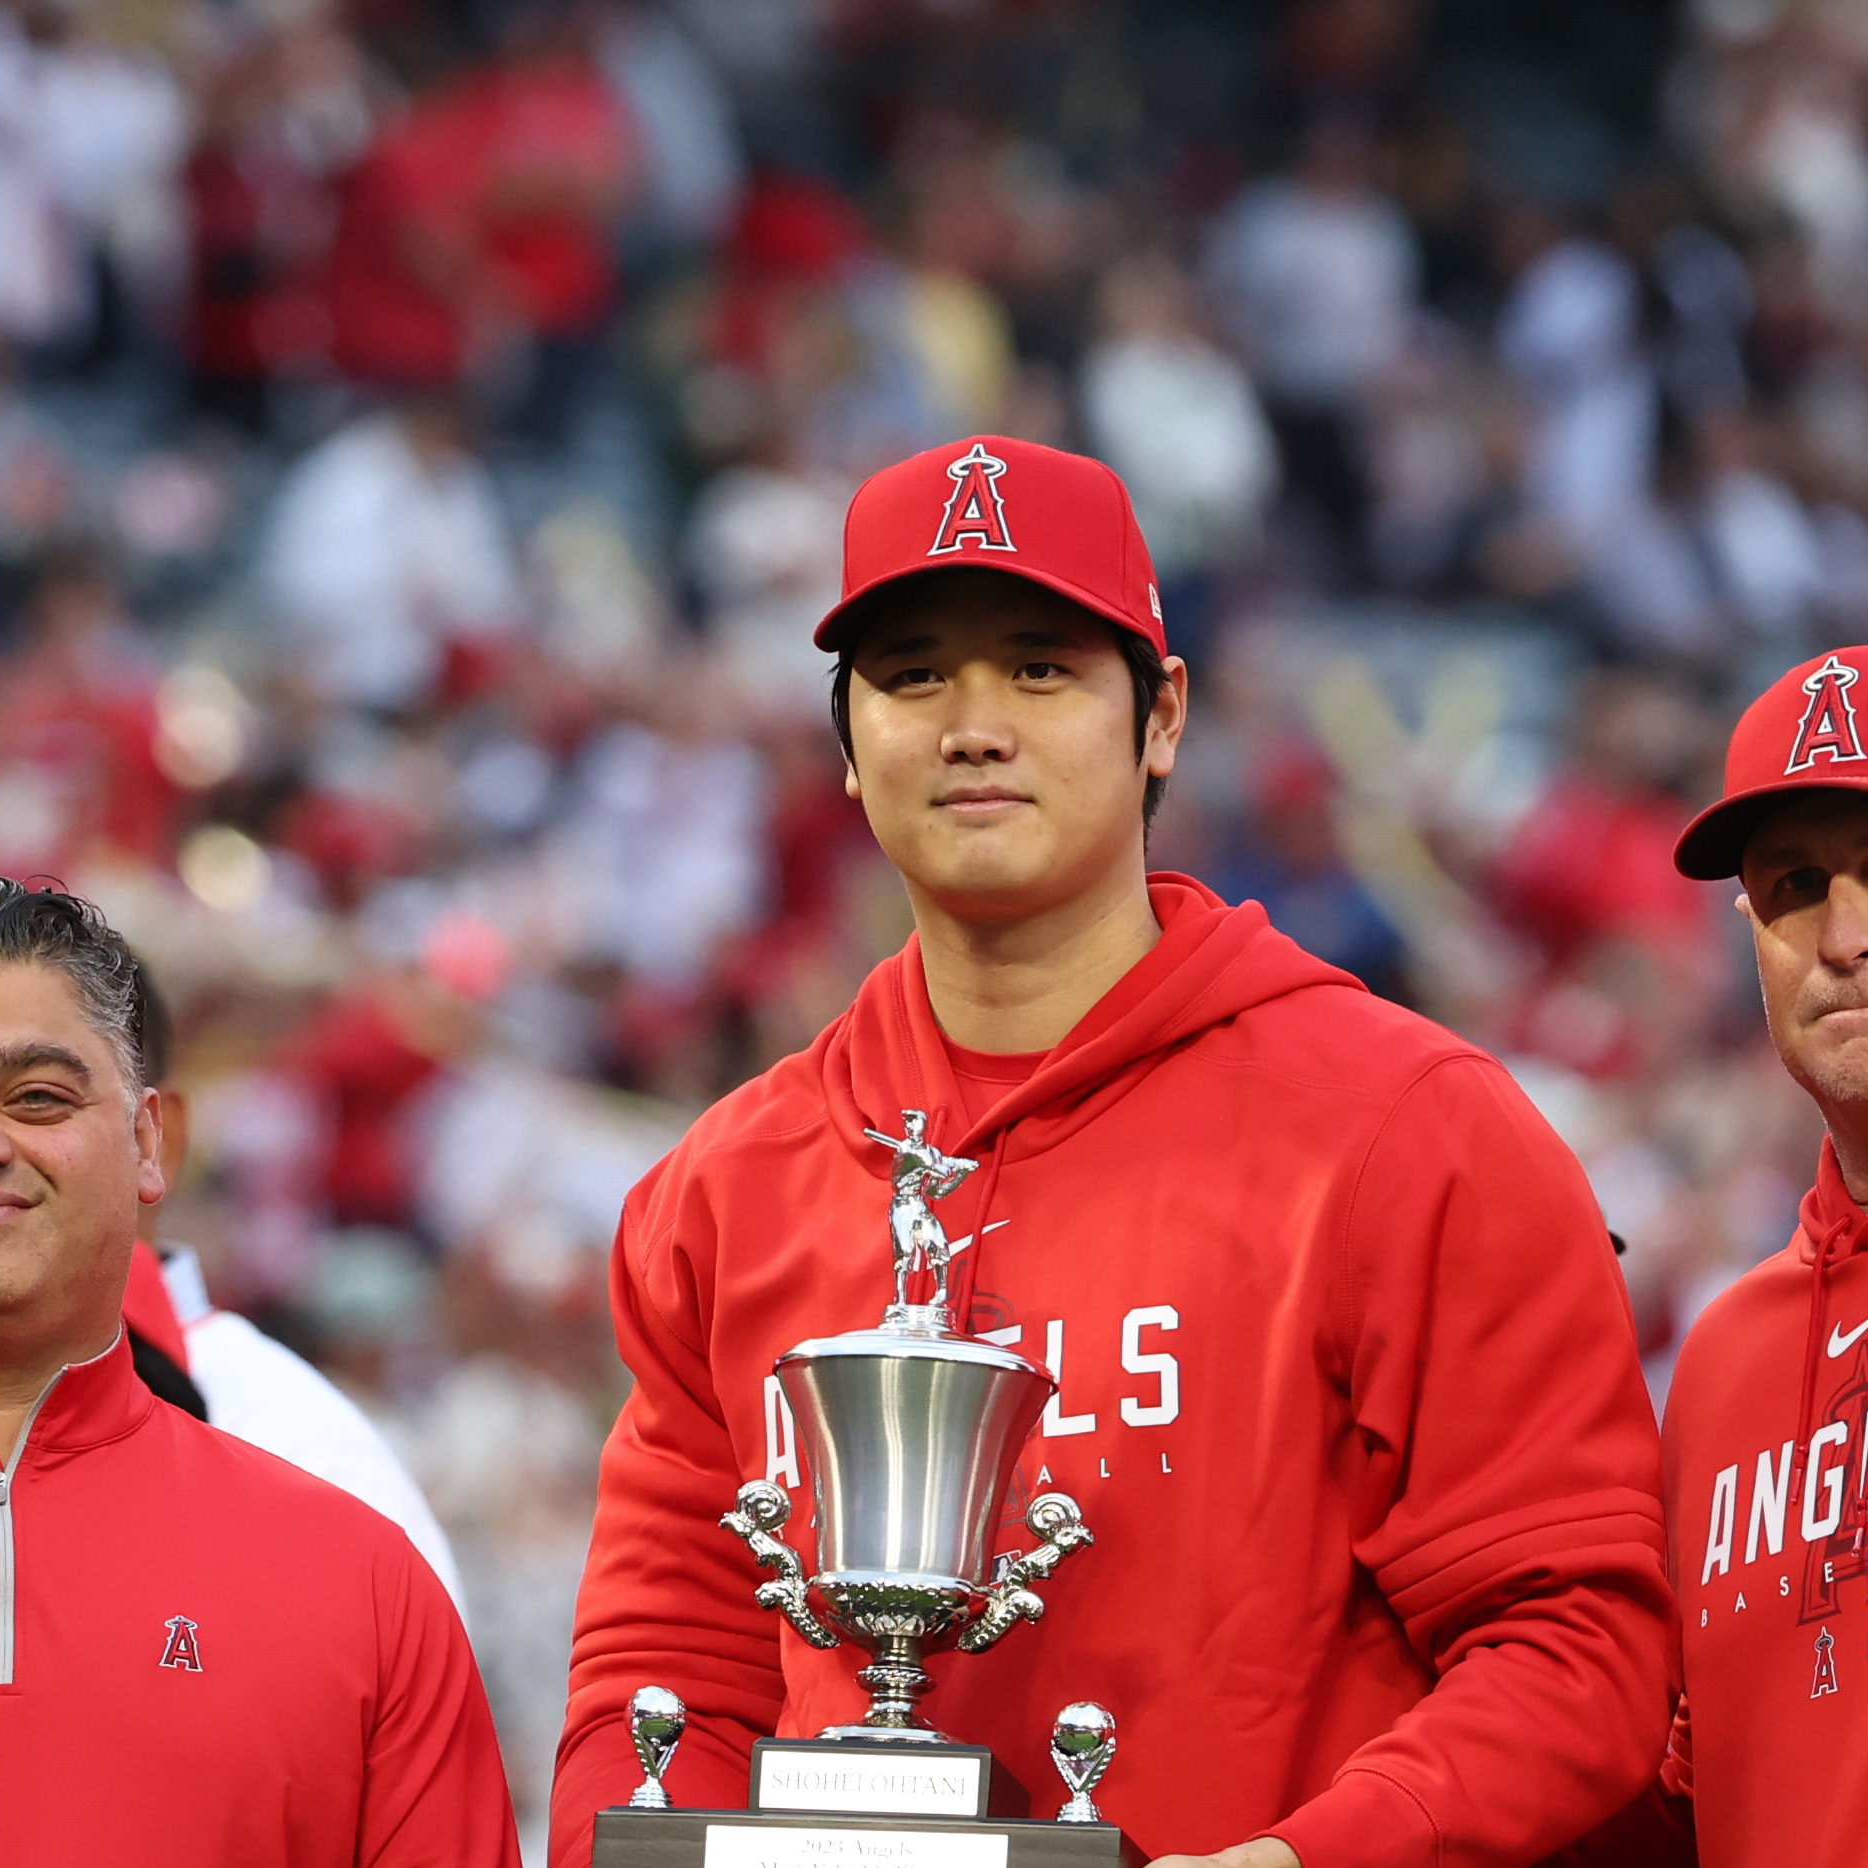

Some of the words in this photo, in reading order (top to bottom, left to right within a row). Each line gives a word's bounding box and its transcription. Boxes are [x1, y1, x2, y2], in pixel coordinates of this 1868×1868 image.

[926, 443, 1018, 557] A
[1784, 655, 1868, 776] A
[159, 1614, 203, 1672] A
[1810, 1626, 1838, 1699] A
[772, 1770, 862, 1792] SHOHEI
[871, 1774, 966, 1796] OHTANI
[801, 1839, 843, 1855] 2023
[853, 1840, 913, 1860] Angels
